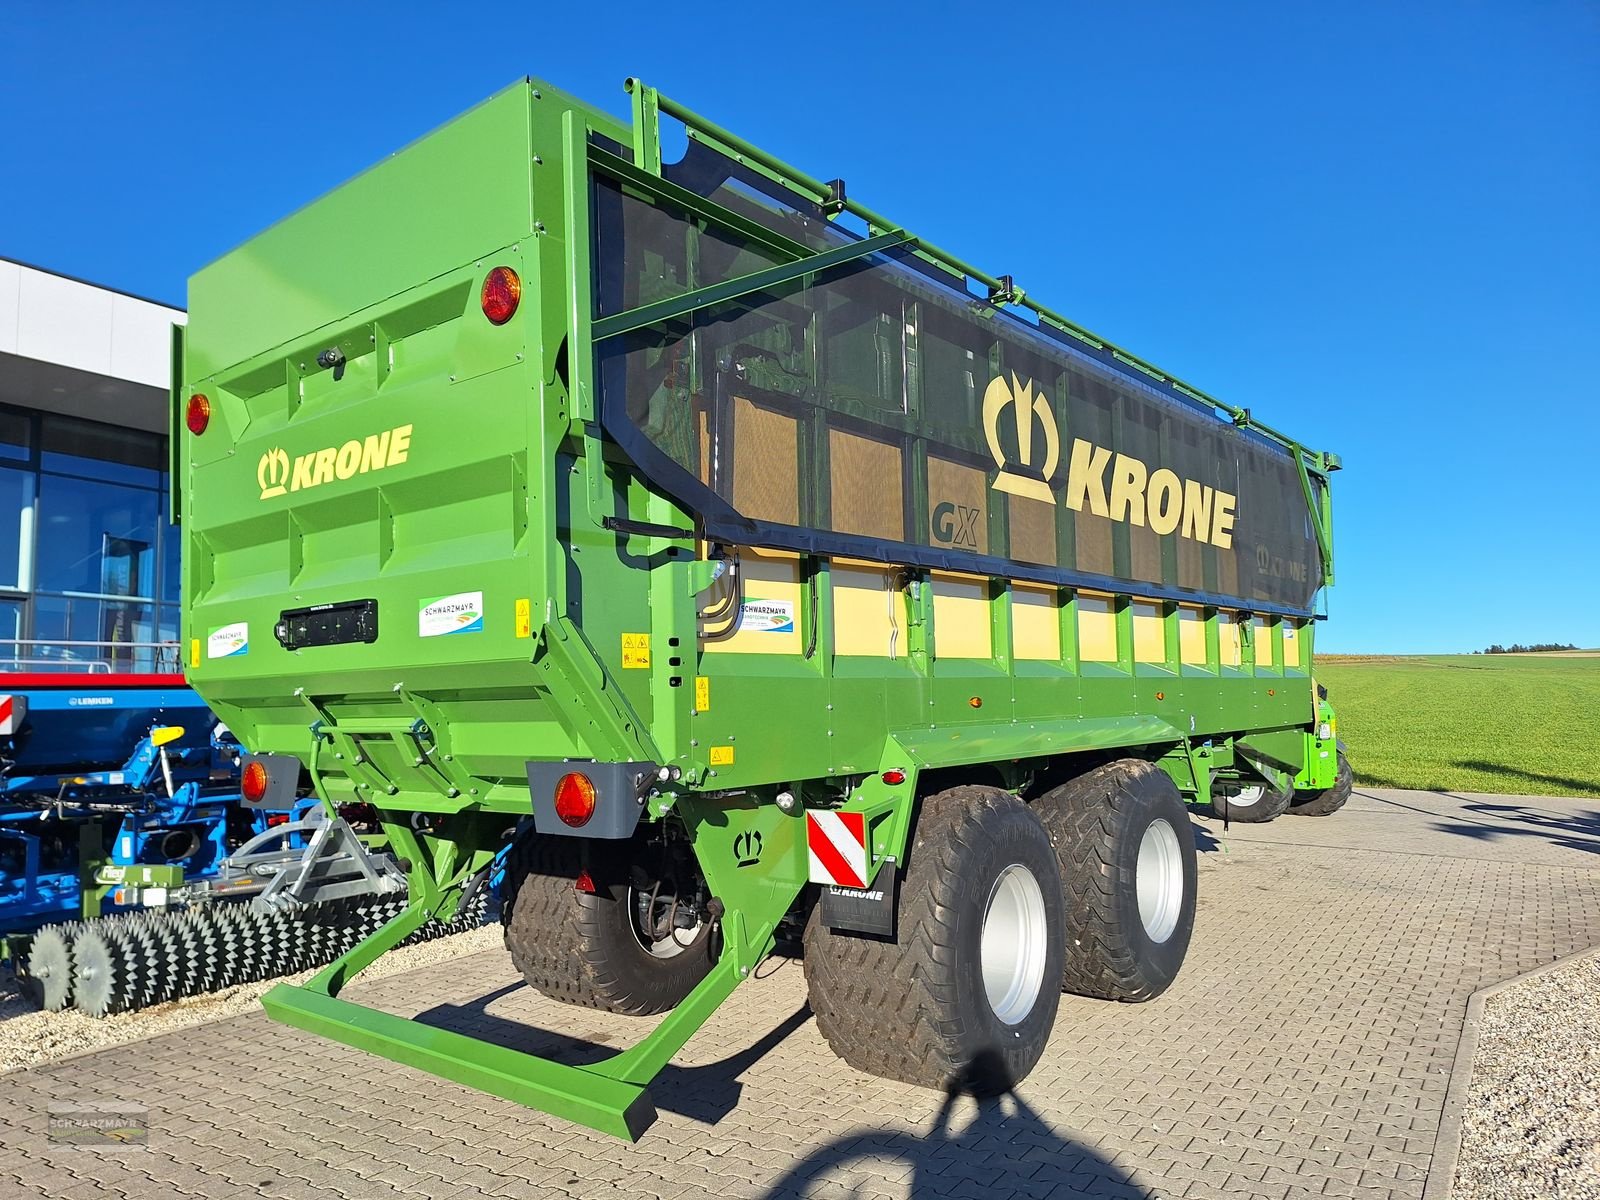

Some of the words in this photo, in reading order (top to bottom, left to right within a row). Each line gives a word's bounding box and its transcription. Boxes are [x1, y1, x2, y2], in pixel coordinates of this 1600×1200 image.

[290, 423, 413, 492] KRONE
[1066, 438, 1236, 550] KRONE
[932, 501, 980, 547] GX
[425, 602, 474, 616] SCHWARZMAYR
[740, 605, 786, 614] SCHWARZMAYR
[77, 697, 113, 705] LEMKEN
